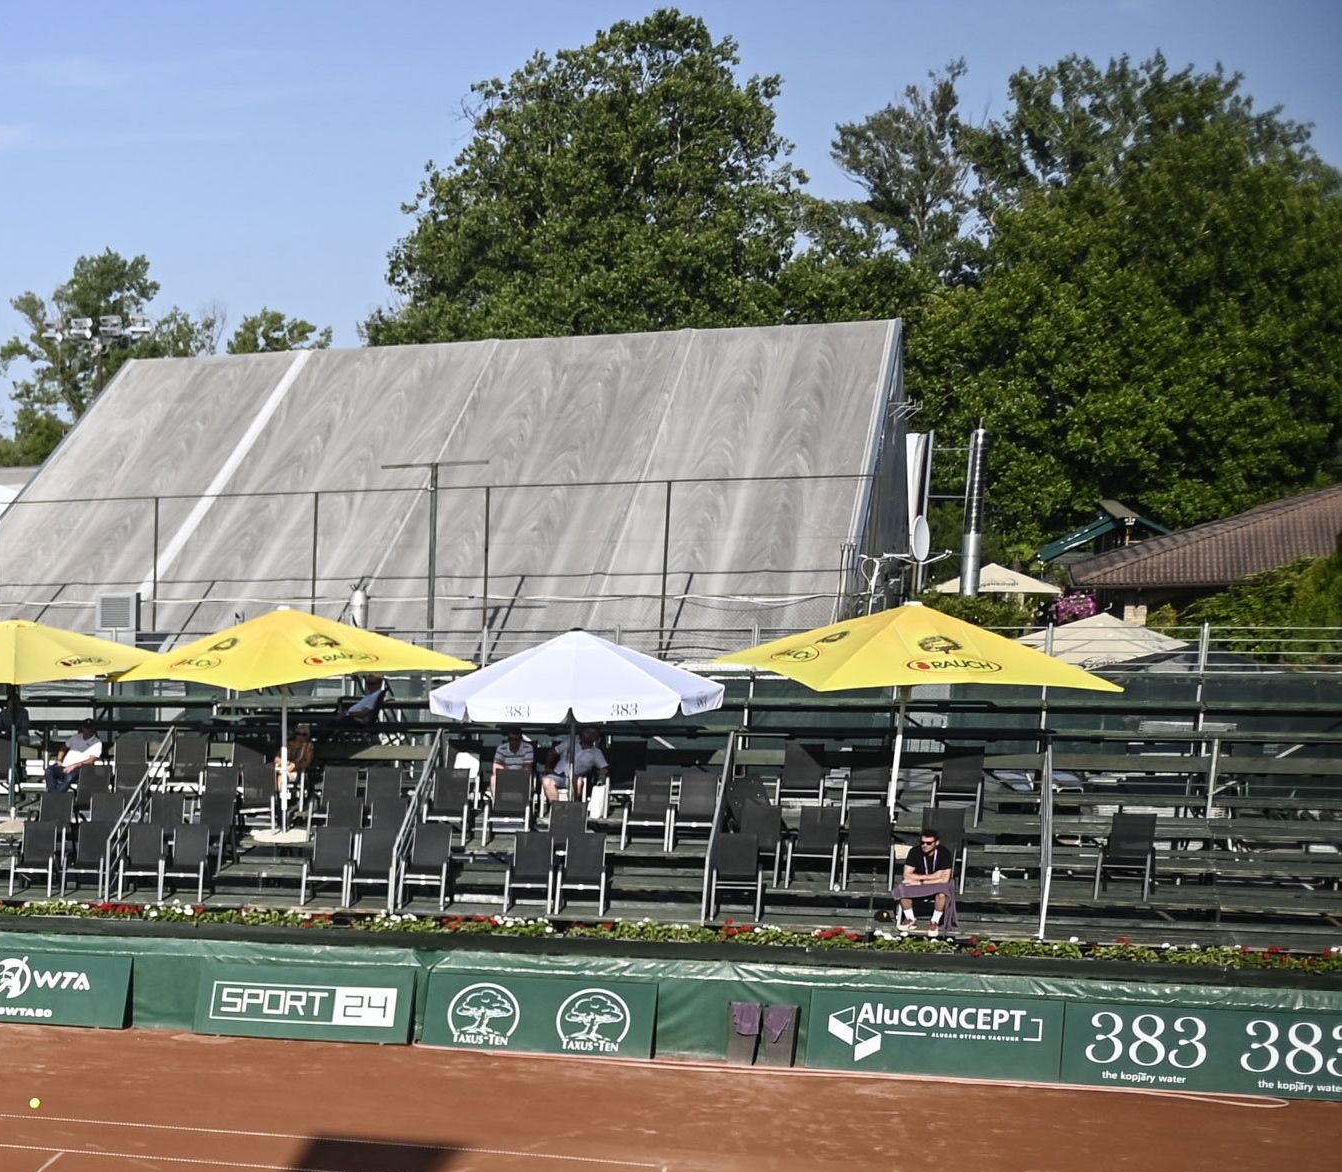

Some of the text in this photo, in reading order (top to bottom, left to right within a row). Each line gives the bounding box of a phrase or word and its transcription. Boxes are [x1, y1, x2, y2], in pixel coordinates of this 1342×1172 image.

[932, 659, 994, 670] RAUCH
[504, 705, 530, 718] 383
[610, 703, 638, 716] 383
[33, 970, 91, 991] WTA
[220, 987, 389, 1018] SPORT 24
[857, 1002, 1027, 1032] AluCONCEPT
[453, 1032, 508, 1046] TAXUS-TEN
[562, 1038, 619, 1052] TAXUS-TEN
[1085, 1012, 1207, 1069] 383
[1101, 1070, 1118, 1080] the
[1158, 1075, 1187, 1083] water
[1257, 1079, 1274, 1089] the
